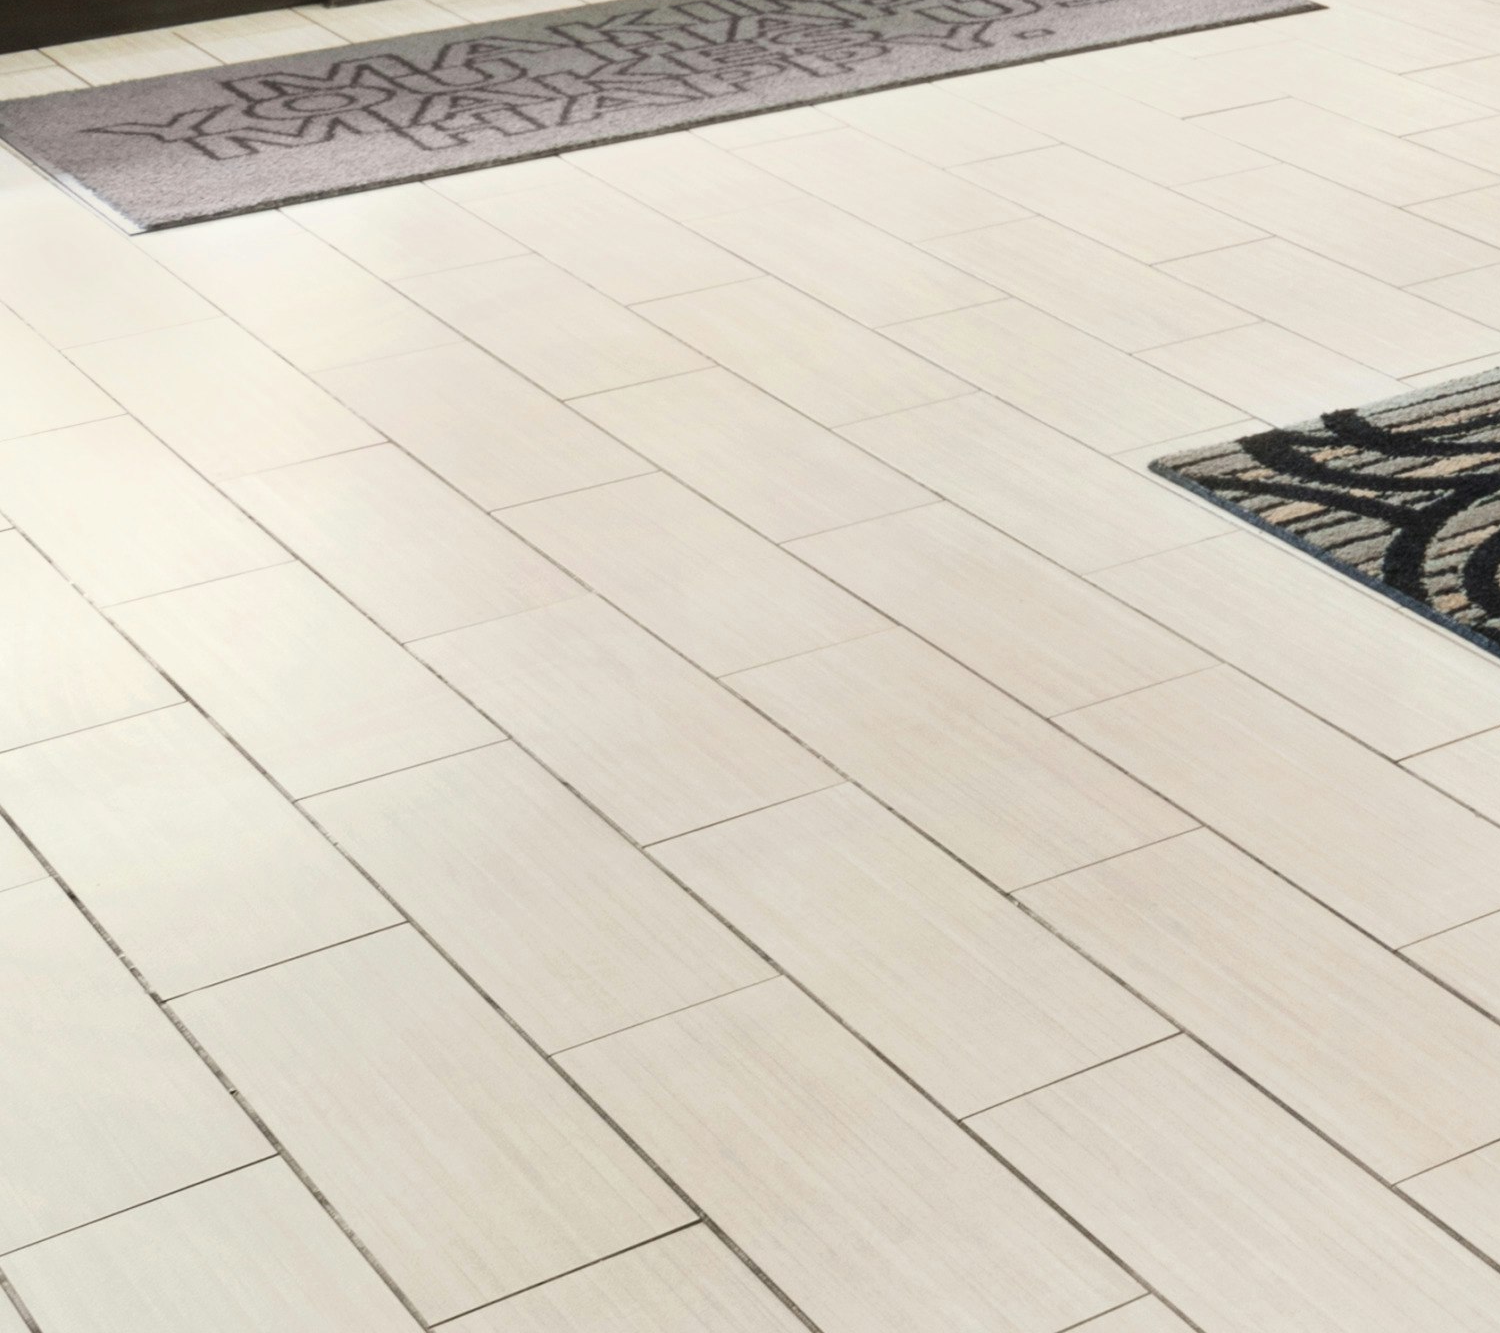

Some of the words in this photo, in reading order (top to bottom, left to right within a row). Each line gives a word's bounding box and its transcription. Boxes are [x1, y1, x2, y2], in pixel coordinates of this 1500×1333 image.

[83, 57, 534, 141] YOU
[182, 22, 888, 160] MAKES
[389, 19, 1058, 149] HAPPY.
